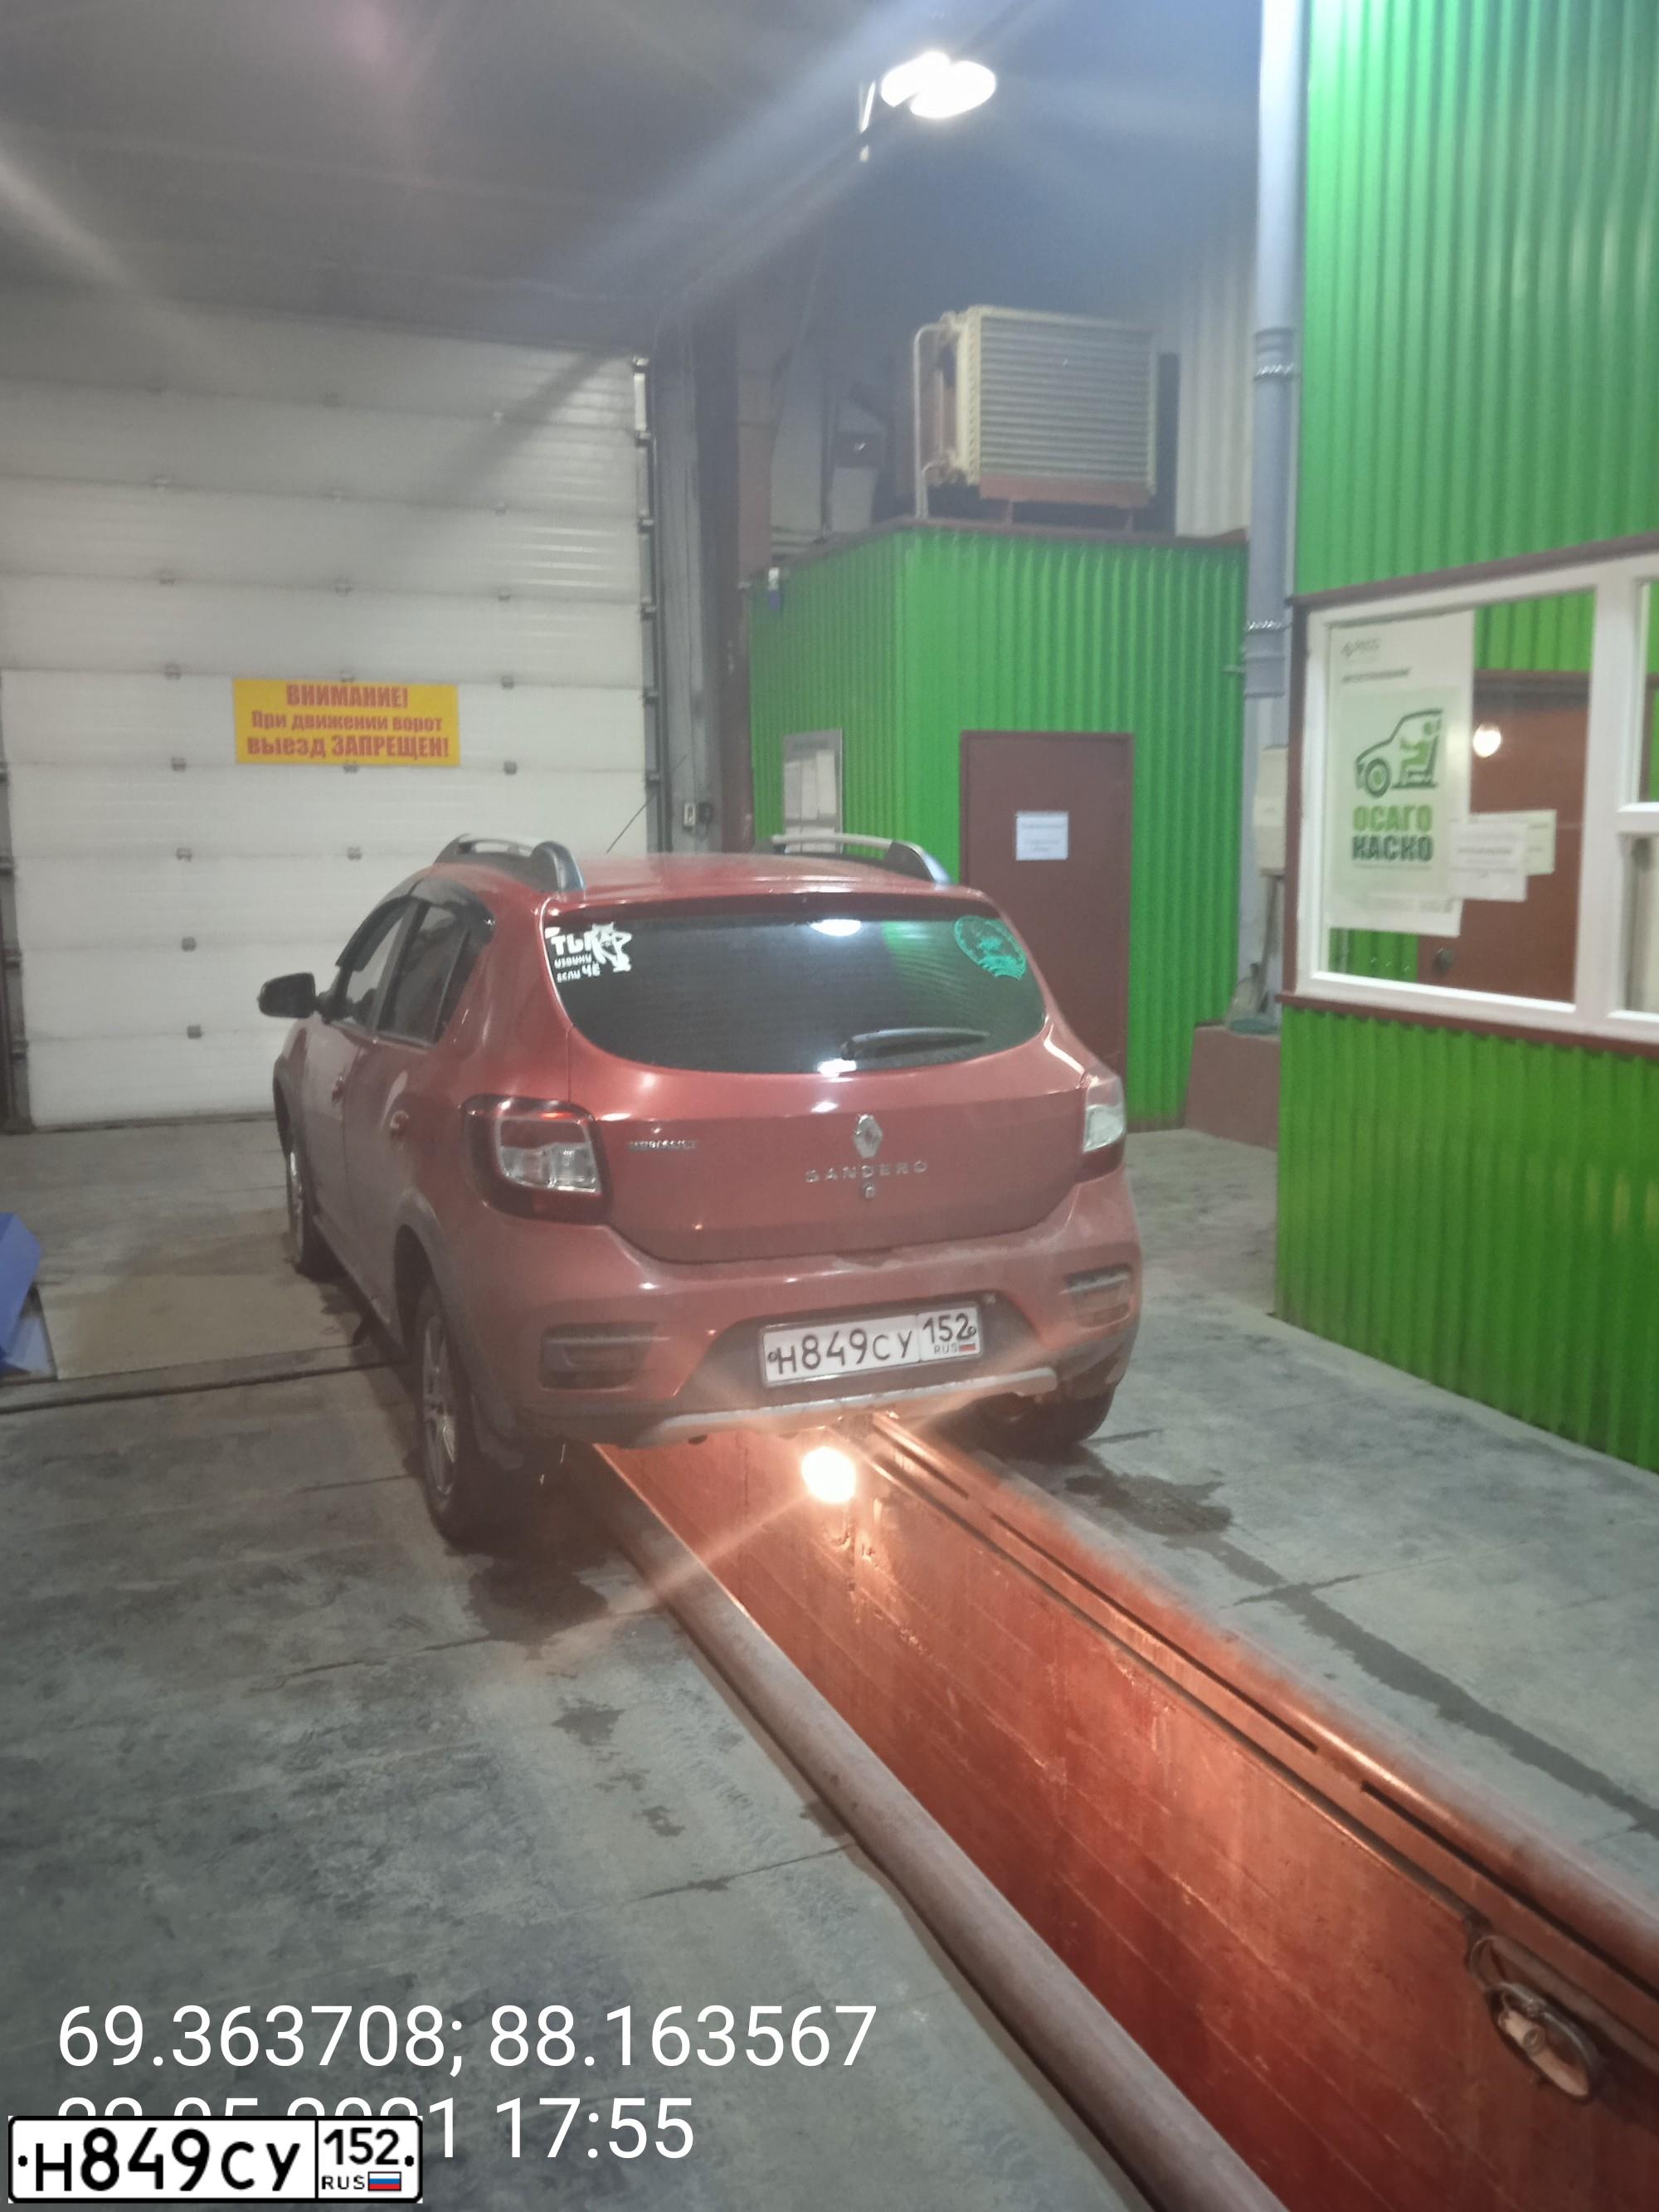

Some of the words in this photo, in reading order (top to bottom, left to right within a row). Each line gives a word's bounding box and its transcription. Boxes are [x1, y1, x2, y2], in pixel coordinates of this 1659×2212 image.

[286, 685, 408, 708] ВНИМАНИЕ!
[251, 710, 287, 729] При
[291, 714, 388, 731] движении
[392, 716, 442, 733] ворот
[247, 736, 326, 758] выезд
[331, 734, 449, 760] ЗАПРЕЩЕН!
[1353, 805, 1433, 832] ОСАГО
[1352, 835, 1433, 861] КАСКО
[805, 1160, 927, 1182] SANDERO
[922, 1313, 971, 1344] 152
